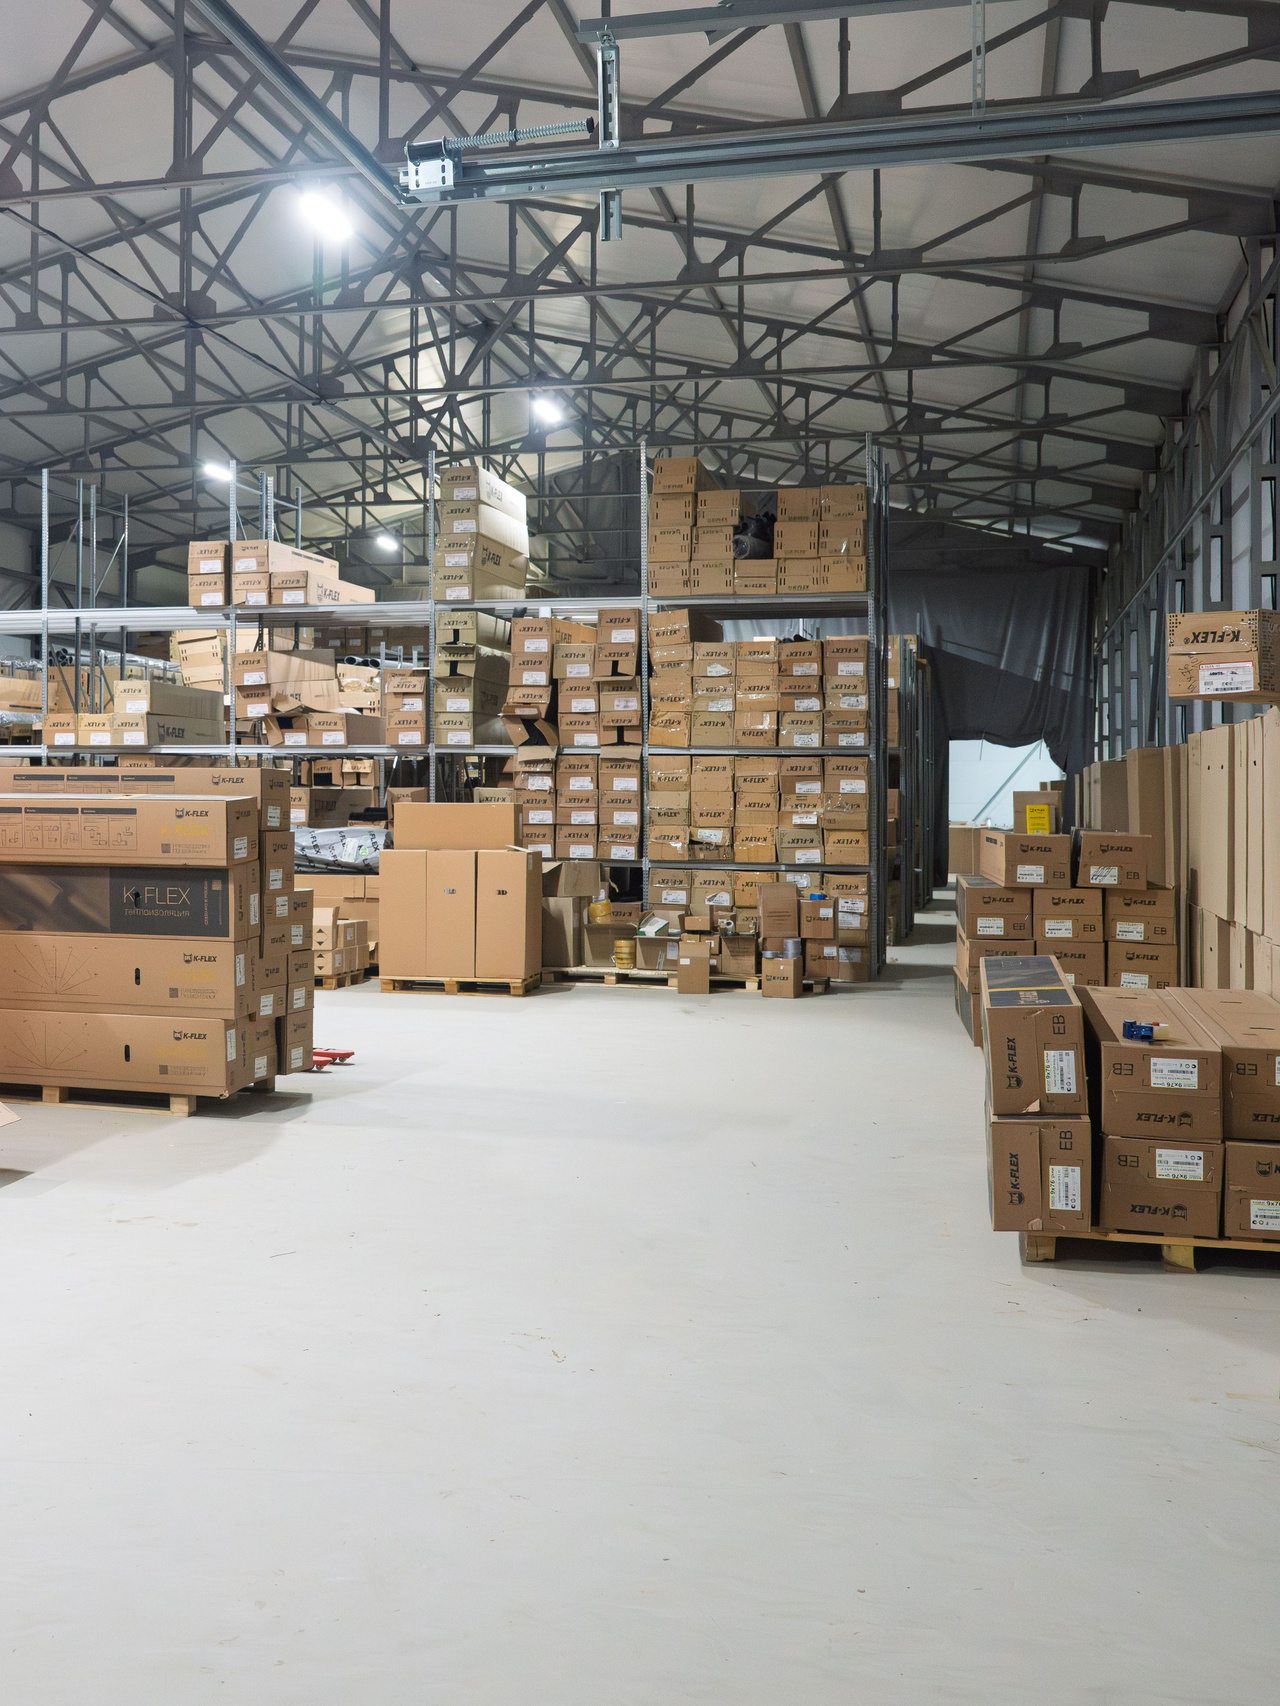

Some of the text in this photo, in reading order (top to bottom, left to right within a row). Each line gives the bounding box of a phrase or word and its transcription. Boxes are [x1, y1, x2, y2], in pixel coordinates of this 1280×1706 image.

[323, 588, 341, 601] K-FLEX
[166, 726, 185, 739] K-FLEX
[1053, 871, 1065, 879] EB
[123, 886, 190, 905] KFLEX
[1083, 924, 1096, 932] EB
[1154, 927, 1166, 935] EB
[1053, 1015, 1065, 1034] EB
[1007, 1037, 1018, 1073] K-FLEX
[1112, 1063, 1133, 1075] EB
[1236, 1063, 1257, 1075] EB
[1136, 1113, 1176, 1123] K-FLEX
[1252, 1113, 1280, 1122] FLEX
[1060, 1131, 1072, 1150] EB
[1118, 1155, 1139, 1167] EB
[1009, 1153, 1019, 1190] K-FLEX
[1130, 1204, 1170, 1215] K-FLEX
